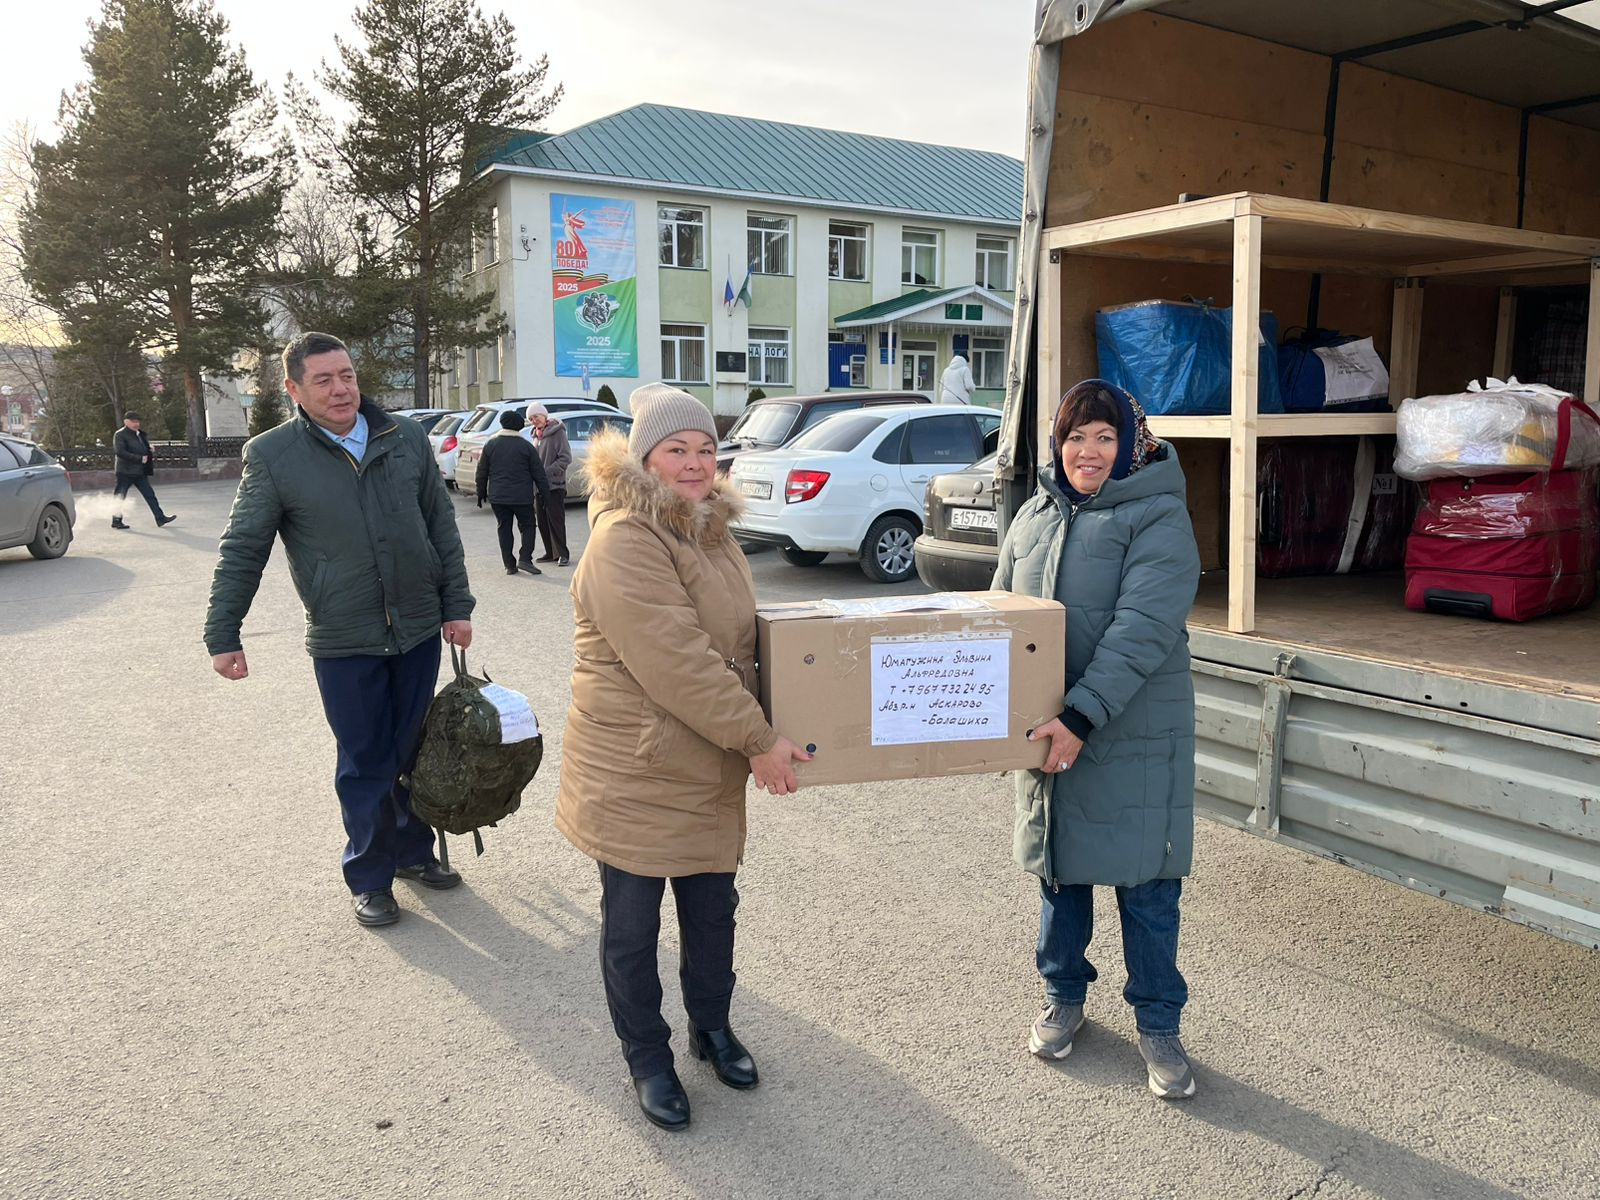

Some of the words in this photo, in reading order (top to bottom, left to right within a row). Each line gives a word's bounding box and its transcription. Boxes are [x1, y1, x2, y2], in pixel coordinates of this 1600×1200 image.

[556, 240, 576, 257] 80
[556, 259, 589, 270] ПОБЕДА!
[557, 283, 578, 291] 2025
[586, 336, 611, 346] 2025
